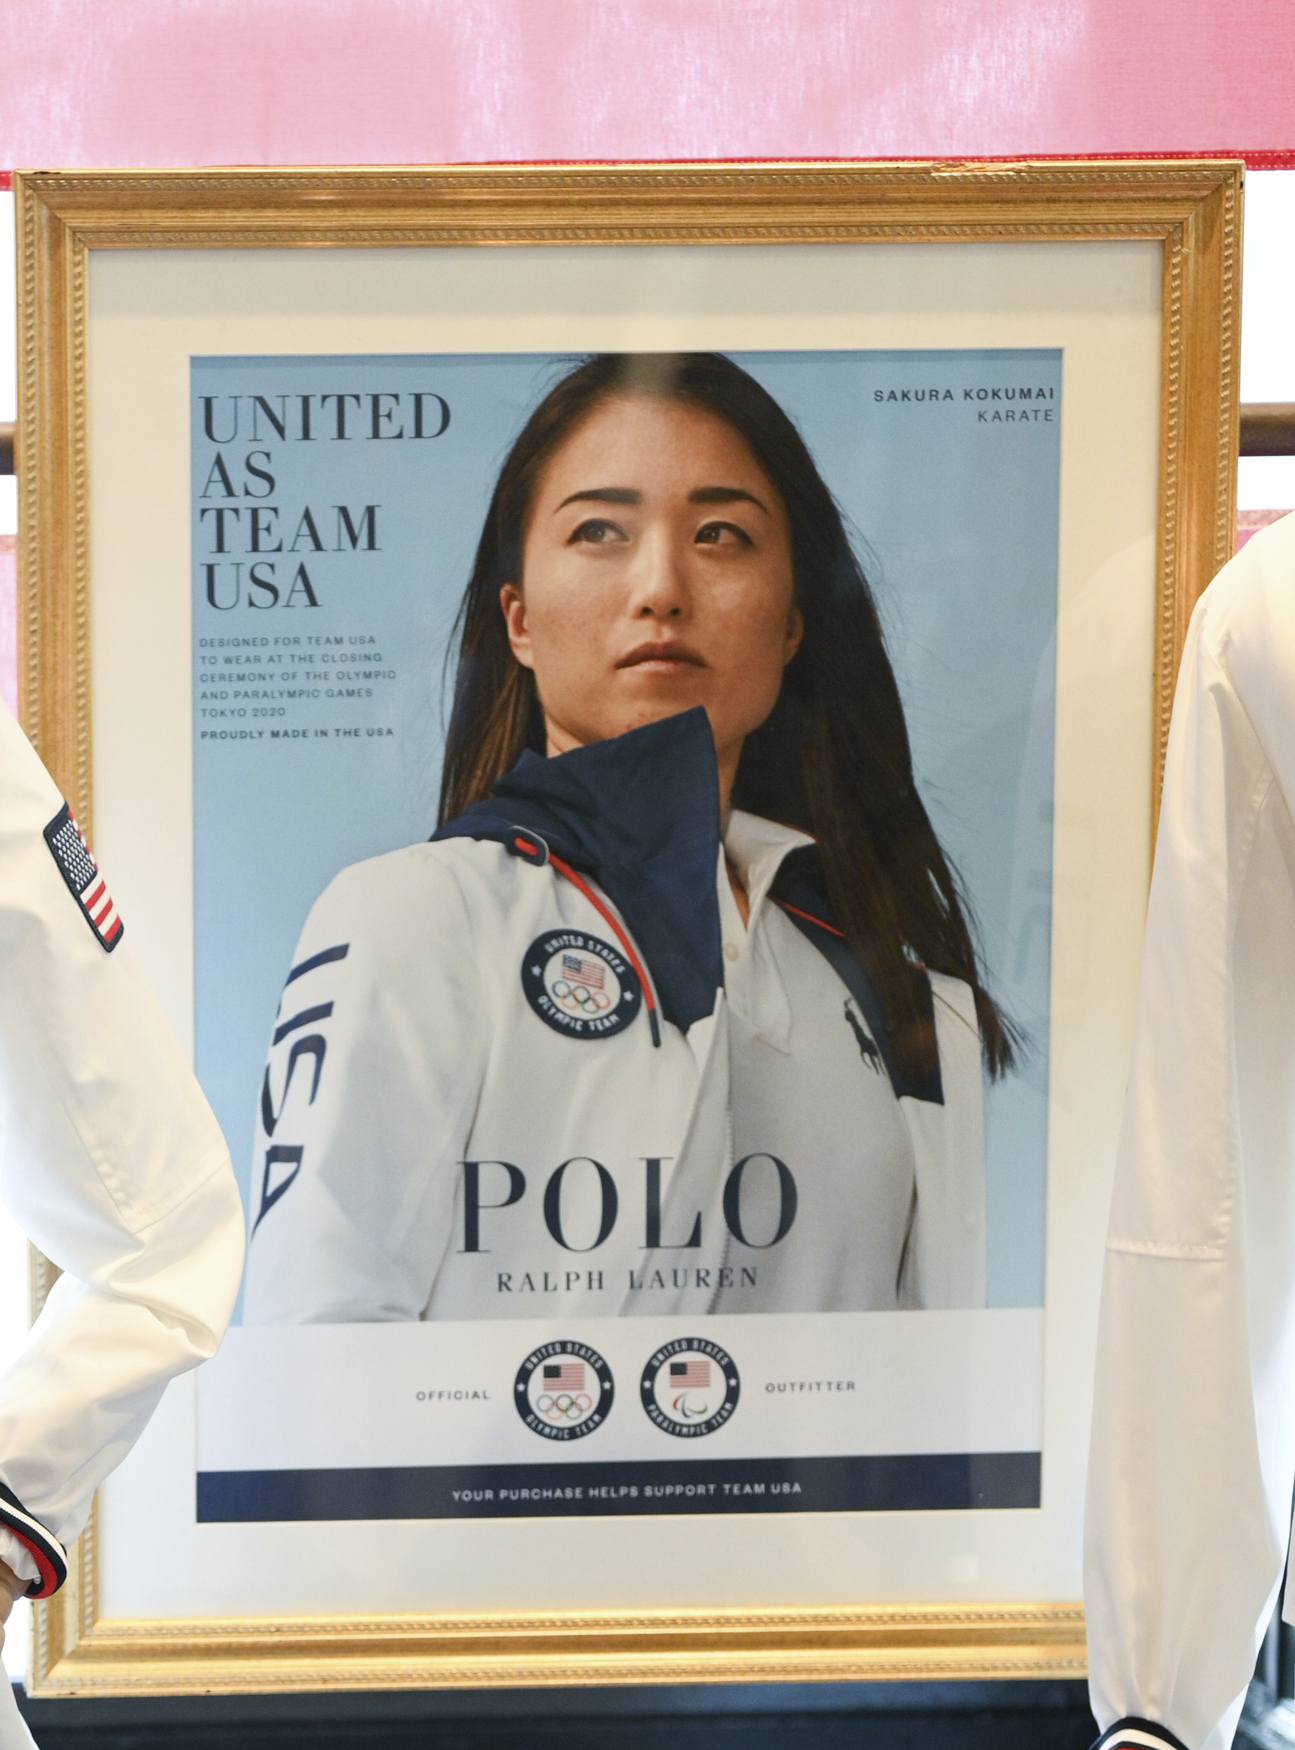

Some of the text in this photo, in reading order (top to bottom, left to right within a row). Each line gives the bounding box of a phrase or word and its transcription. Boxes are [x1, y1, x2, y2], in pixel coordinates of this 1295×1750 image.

[874, 387, 1054, 402] SAKURA KOKUMAI
[198, 393, 451, 443] UNITED
[978, 409, 1054, 422] KARATE
[198, 451, 275, 498] AS
[199, 505, 382, 553] TEAM
[199, 561, 323, 610] USA
[199, 635, 376, 647] DESIGNED FOR TEAM USA
[200, 652, 383, 665] TO WEAR AT THE CLOSING
[199, 670, 396, 683] CEREMONY OF THE OLYMPIC
[200, 688, 373, 700] AND PARALYMPIC GAMES
[201, 707, 286, 717] TOKYO 2020
[200, 727, 394, 740] PROUDLY MADE IN THE USA
[456, 1152, 798, 1253] POLO
[497, 1266, 758, 1293] RALPH LAUREN
[524, 1341, 604, 1370] UNITED STATES
[651, 1339, 730, 1367] UNITED STATES
[416, 1390, 491, 1401] OFFICIAL
[765, 1380, 856, 1393] OUTFITTER
[525, 1412, 603, 1439] OLYMPIC TEAM
[647, 1401, 734, 1435] PARALYMPIC TEAM
[453, 1481, 803, 1501] YOUR PURCHASE HELPS SUPPORT TEAM USA
